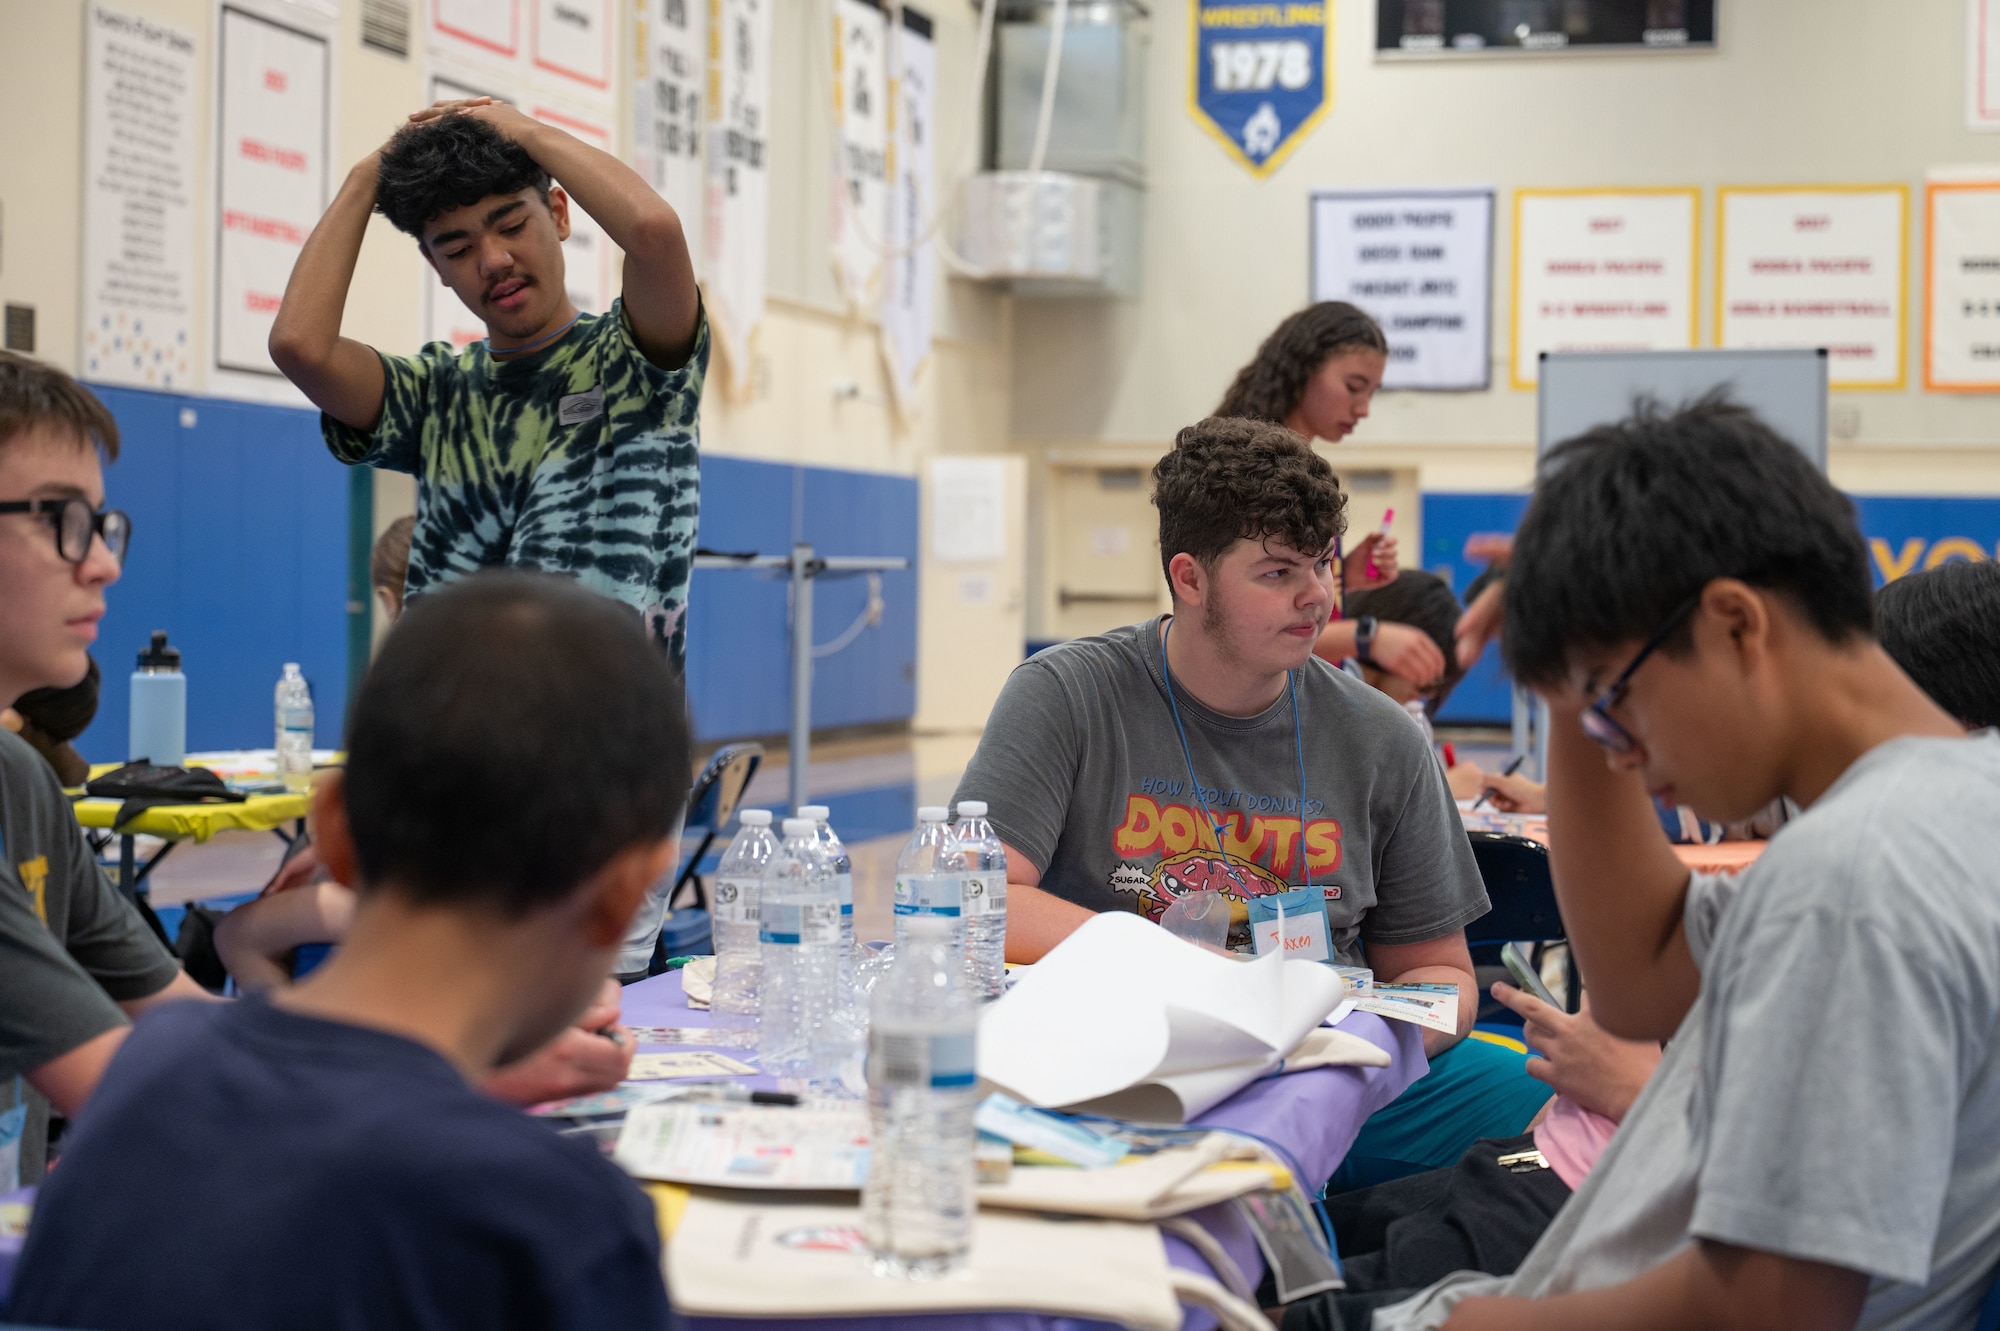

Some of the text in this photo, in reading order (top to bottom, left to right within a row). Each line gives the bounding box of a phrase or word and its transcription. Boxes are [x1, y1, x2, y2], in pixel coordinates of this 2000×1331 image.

[1201, 5, 1323, 27] WRESTLING
[1210, 40, 1312, 91] 1978
[1141, 776, 1325, 815] HOW ABOUT DONUTS?
[1113, 794, 1342, 882] DONUTS
[1114, 876, 1146, 885] SUGAR
